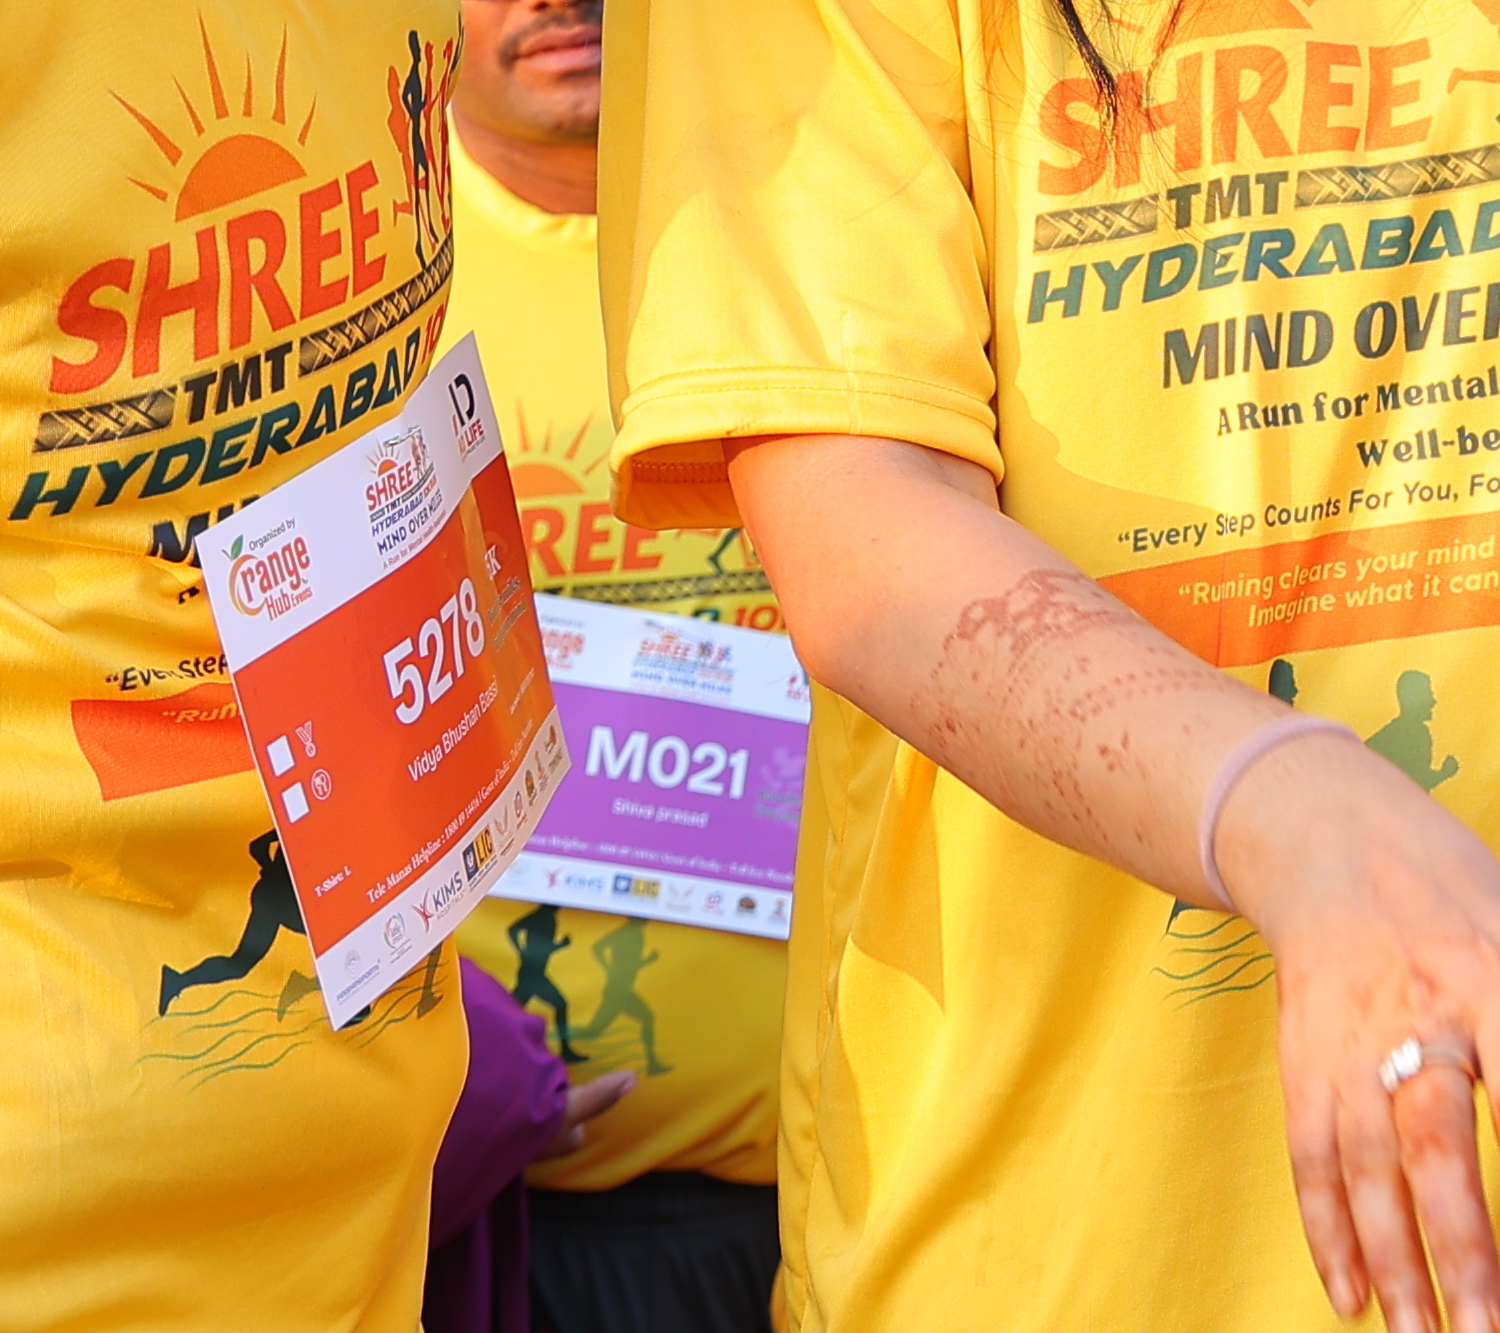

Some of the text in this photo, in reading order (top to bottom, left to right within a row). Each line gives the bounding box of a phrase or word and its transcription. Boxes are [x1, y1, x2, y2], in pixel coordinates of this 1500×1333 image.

[1038, 36, 1434, 197] SHREE
[1165, 170, 1290, 231] TMT
[49, 159, 388, 395] SHREE
[1162, 309, 1334, 389] MIND
[178, 341, 293, 425] TMT
[1216, 406, 1233, 437] A
[1236, 399, 1303, 432] Run
[1312, 390, 1369, 423] for
[1374, 364, 1499, 412] Mental
[7, 325, 421, 522] HYDERABAD
[464, 418, 486, 448] LIFE
[365, 460, 413, 512] SHREE
[371, 492, 424, 539] HYDERABAD
[385, 496, 402, 517] TMT
[1215, 511, 1256, 538] Step
[1263, 495, 1342, 528] Counts
[1348, 488, 1395, 514] For
[1403, 480, 1459, 506] You,
[248, 517, 297, 552] Organized by
[377, 526, 408, 556] MIND
[408, 504, 430, 536] OVER
[1279, 558, 1348, 592] clears
[1356, 548, 1419, 582] your
[1426, 534, 1495, 567] mind
[264, 585, 313, 621] Hub Events
[1247, 589, 1337, 629] Imagine
[1344, 579, 1415, 609] what
[1421, 572, 1441, 599] it
[1448, 569, 1500, 596] can
[381, 578, 486, 725] 5278
[407, 743, 444, 782] Vidya
[440, 698, 482, 760] Bhushan
[584, 723, 750, 801] M021
[366, 878, 387, 904] Tele
[385, 861, 413, 889] Manas
[411, 837, 442, 871] Helpline
[475, 828, 493, 864] LIC
[314, 873, 344, 897] T-Shirt:
[432, 870, 464, 910] KIMS
